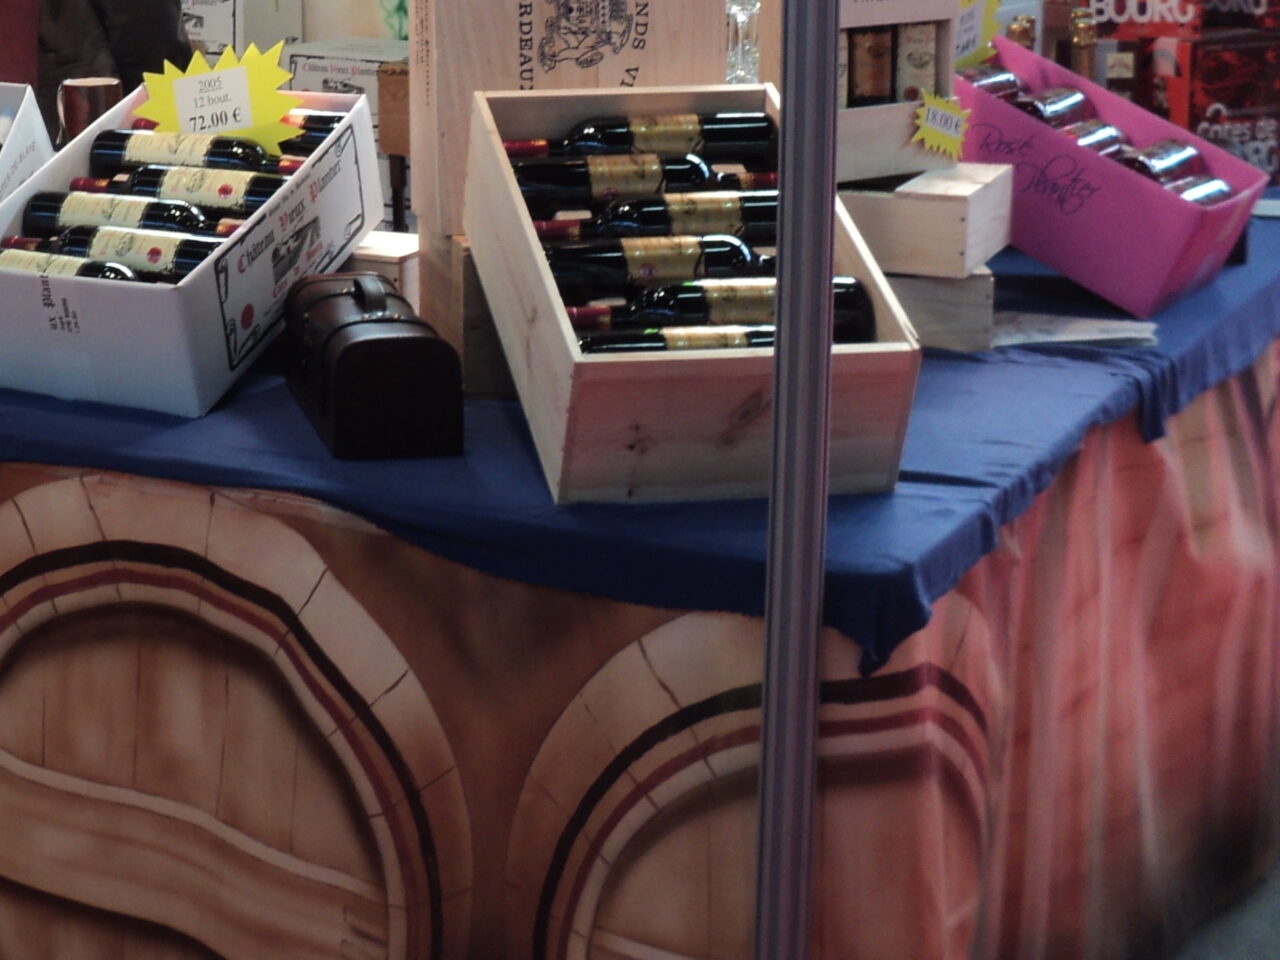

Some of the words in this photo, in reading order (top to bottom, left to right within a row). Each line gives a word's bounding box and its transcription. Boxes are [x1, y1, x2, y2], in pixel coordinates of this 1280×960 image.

[198, 76, 223, 91] 2005
[193, 96, 205, 109] 12
[189, 110, 229, 132] 72.00
[232, 106, 242, 123] €
[925, 106, 953, 130] 18.00
